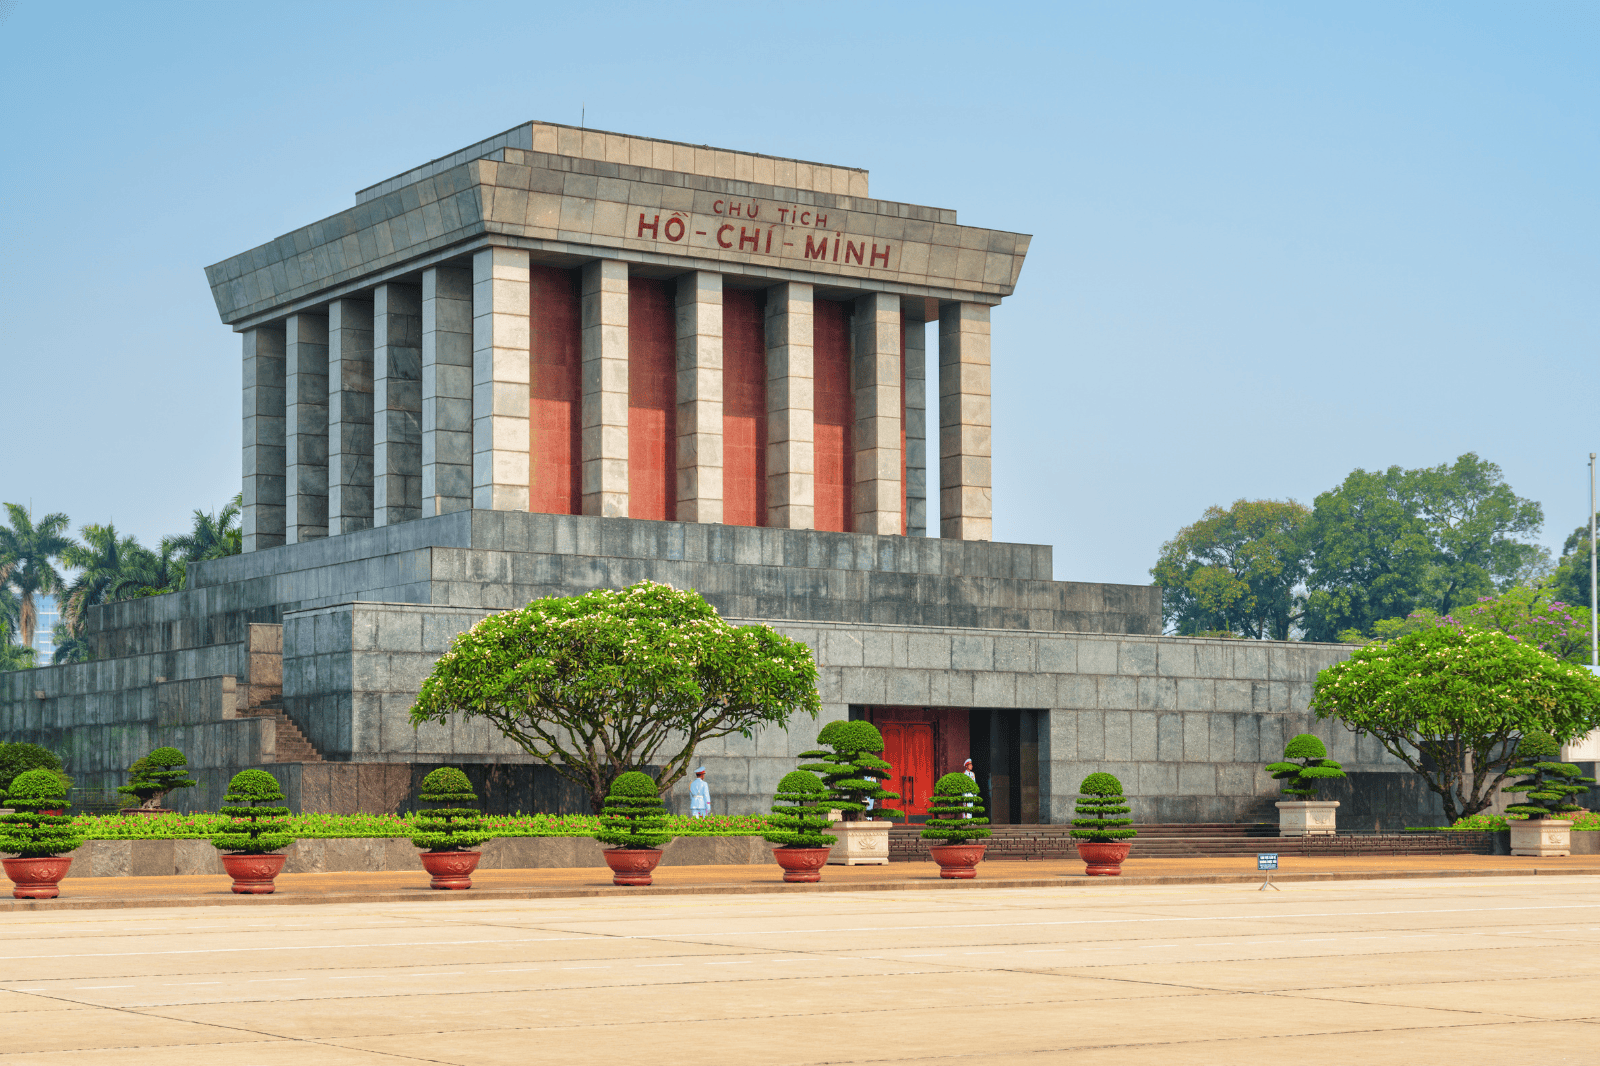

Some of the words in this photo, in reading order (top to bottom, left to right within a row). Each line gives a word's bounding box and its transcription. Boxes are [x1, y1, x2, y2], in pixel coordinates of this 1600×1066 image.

[713, 199, 760, 219] CHỦ
[638, 212, 689, 242] HỒ
[716, 224, 776, 254] CHÍ
